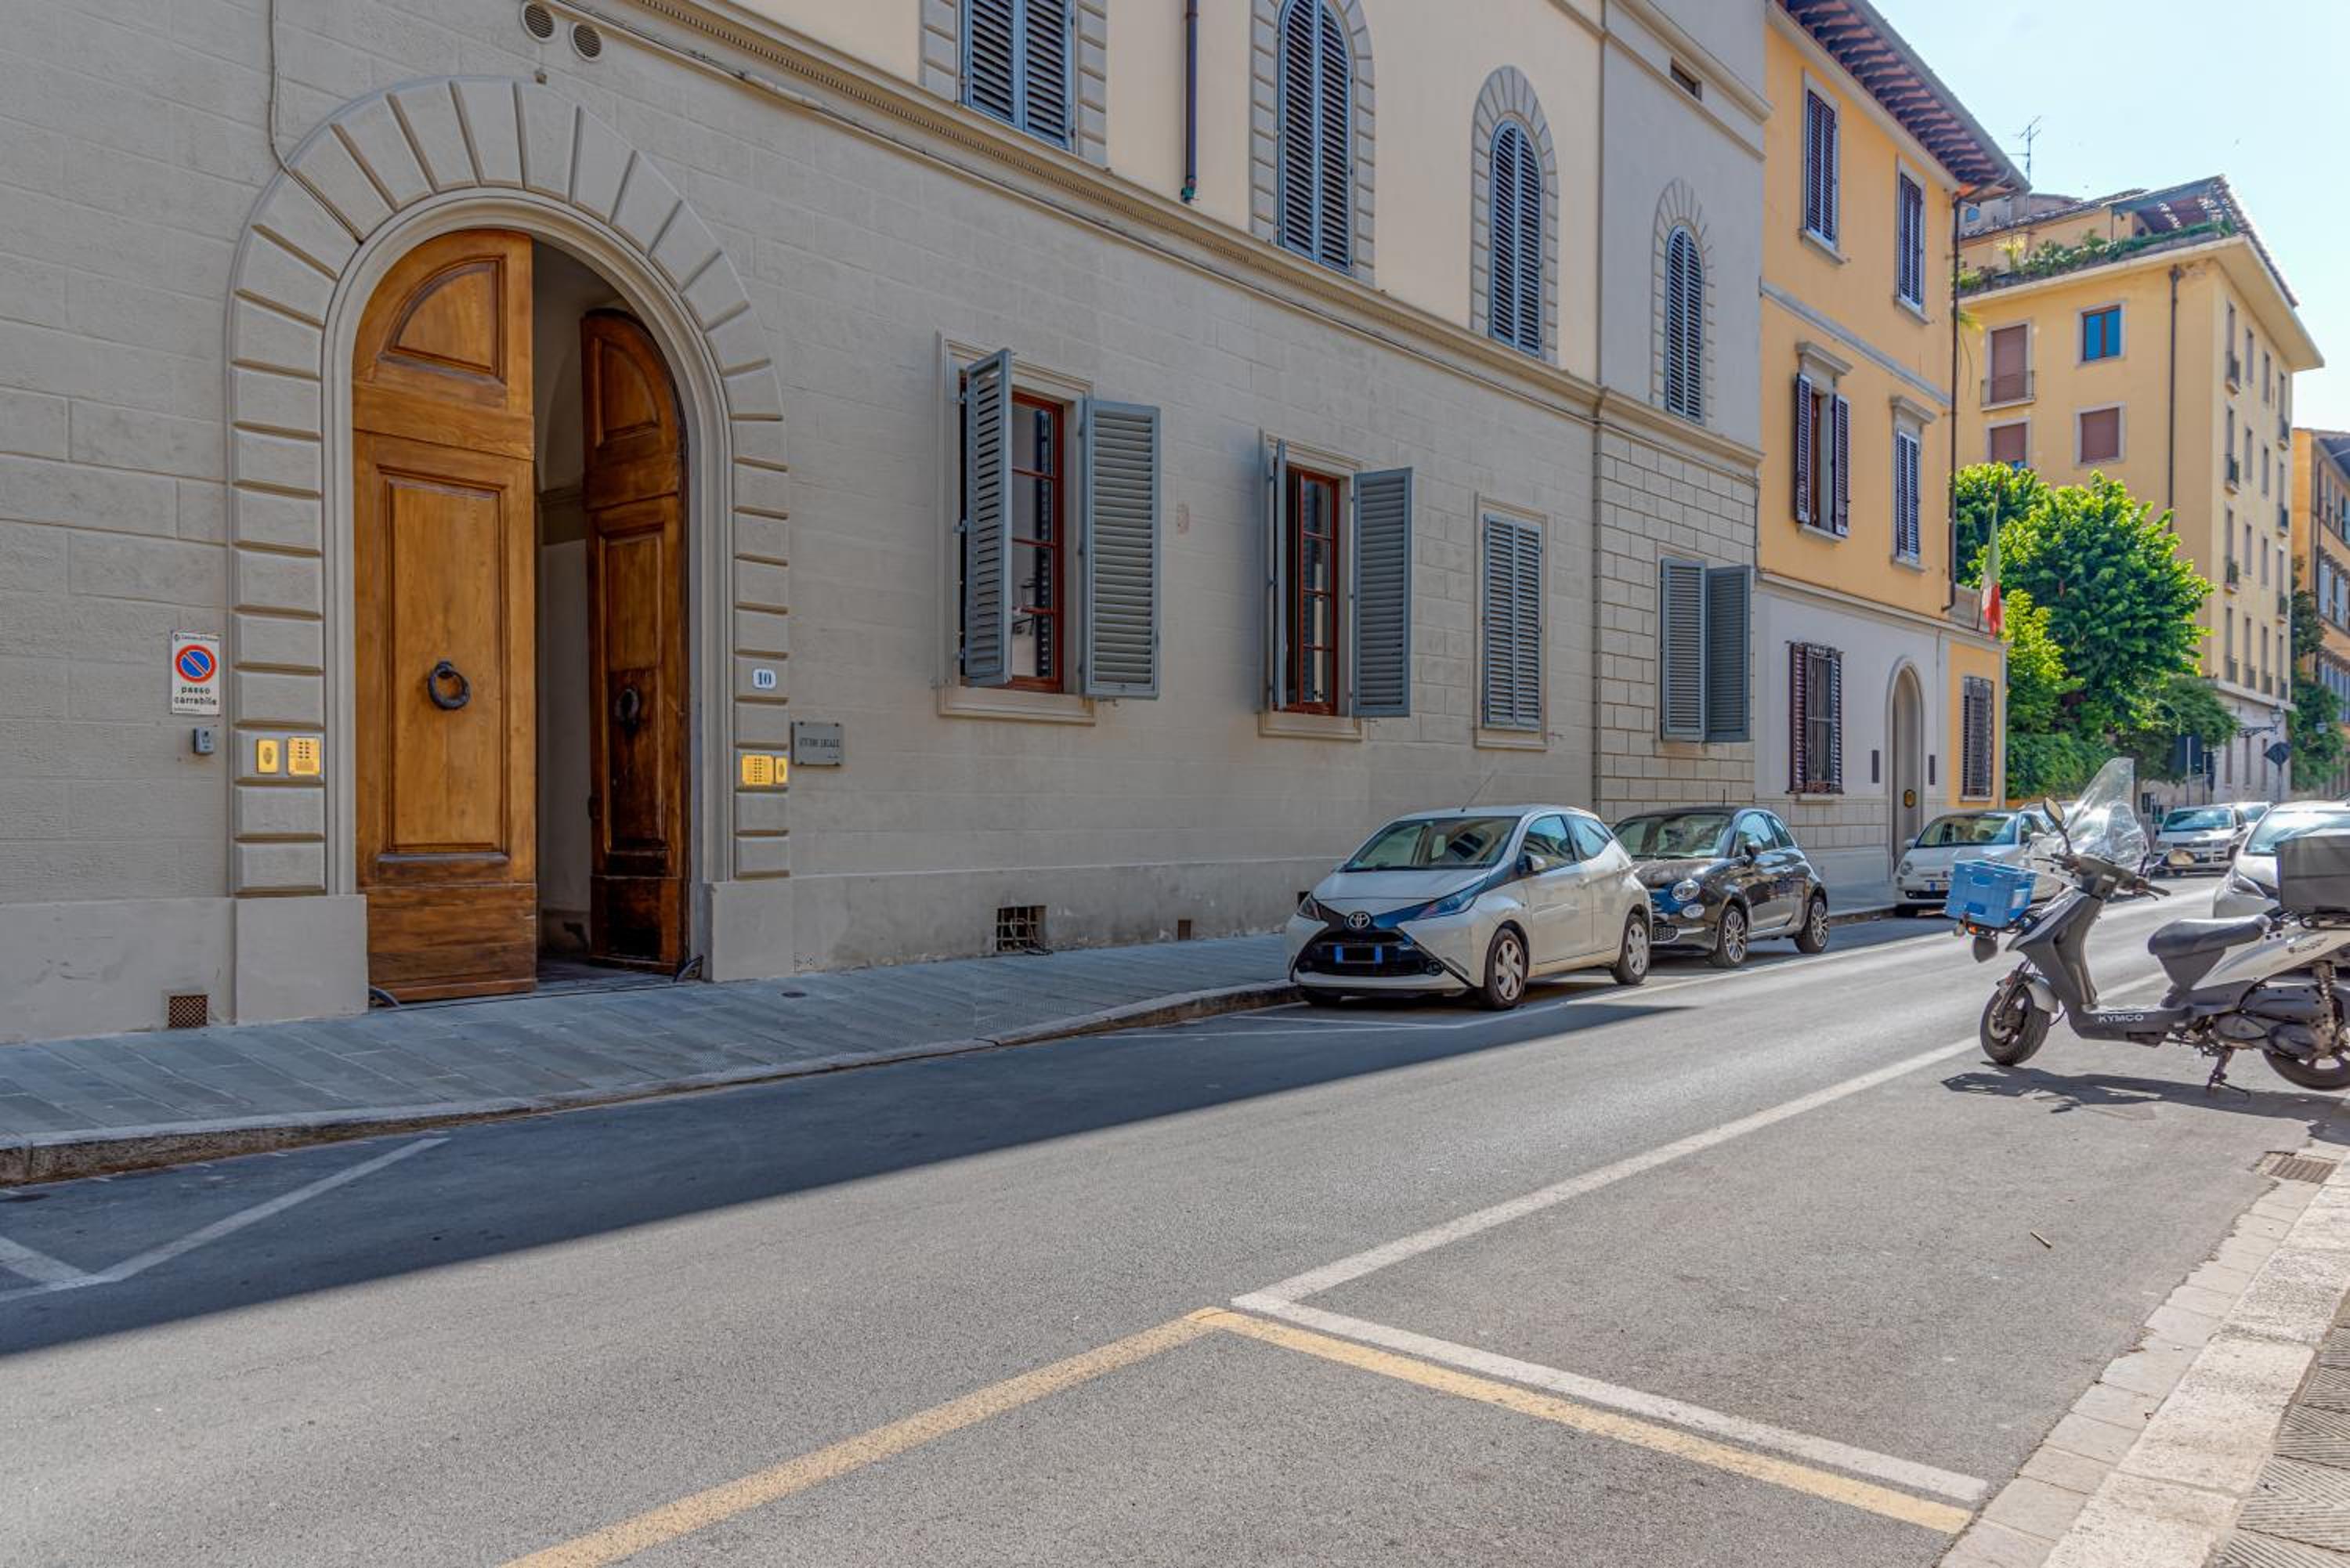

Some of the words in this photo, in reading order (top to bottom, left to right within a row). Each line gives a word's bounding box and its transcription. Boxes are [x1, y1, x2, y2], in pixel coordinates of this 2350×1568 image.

[757, 671, 772, 685] 10
[181, 686, 211, 695] passo
[2099, 1013, 2144, 1023] KYMCO
